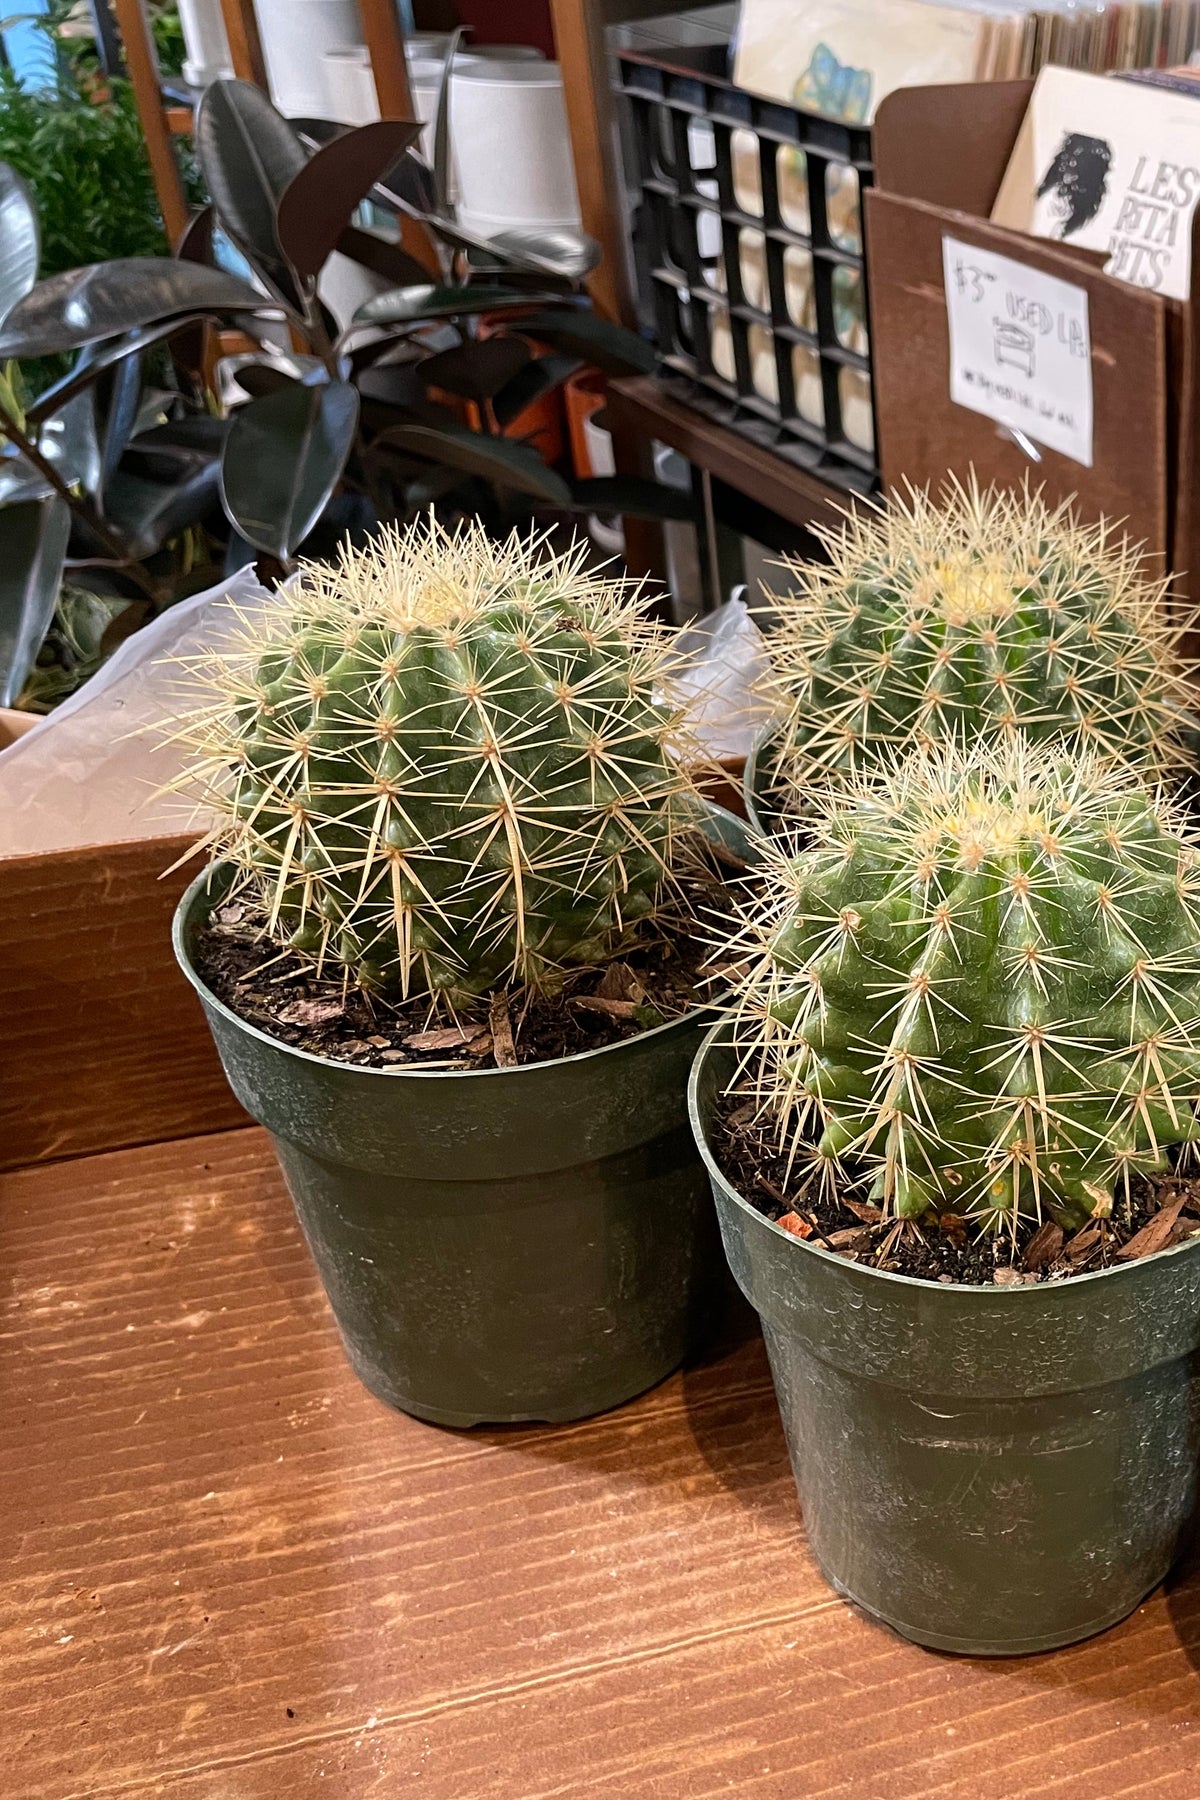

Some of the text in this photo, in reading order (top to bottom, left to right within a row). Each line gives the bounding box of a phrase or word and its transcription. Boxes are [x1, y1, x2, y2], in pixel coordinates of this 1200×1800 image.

[1128, 155, 1200, 208] LES
[1114, 196, 1180, 247] RITA
[1005, 290, 1054, 336] USED
